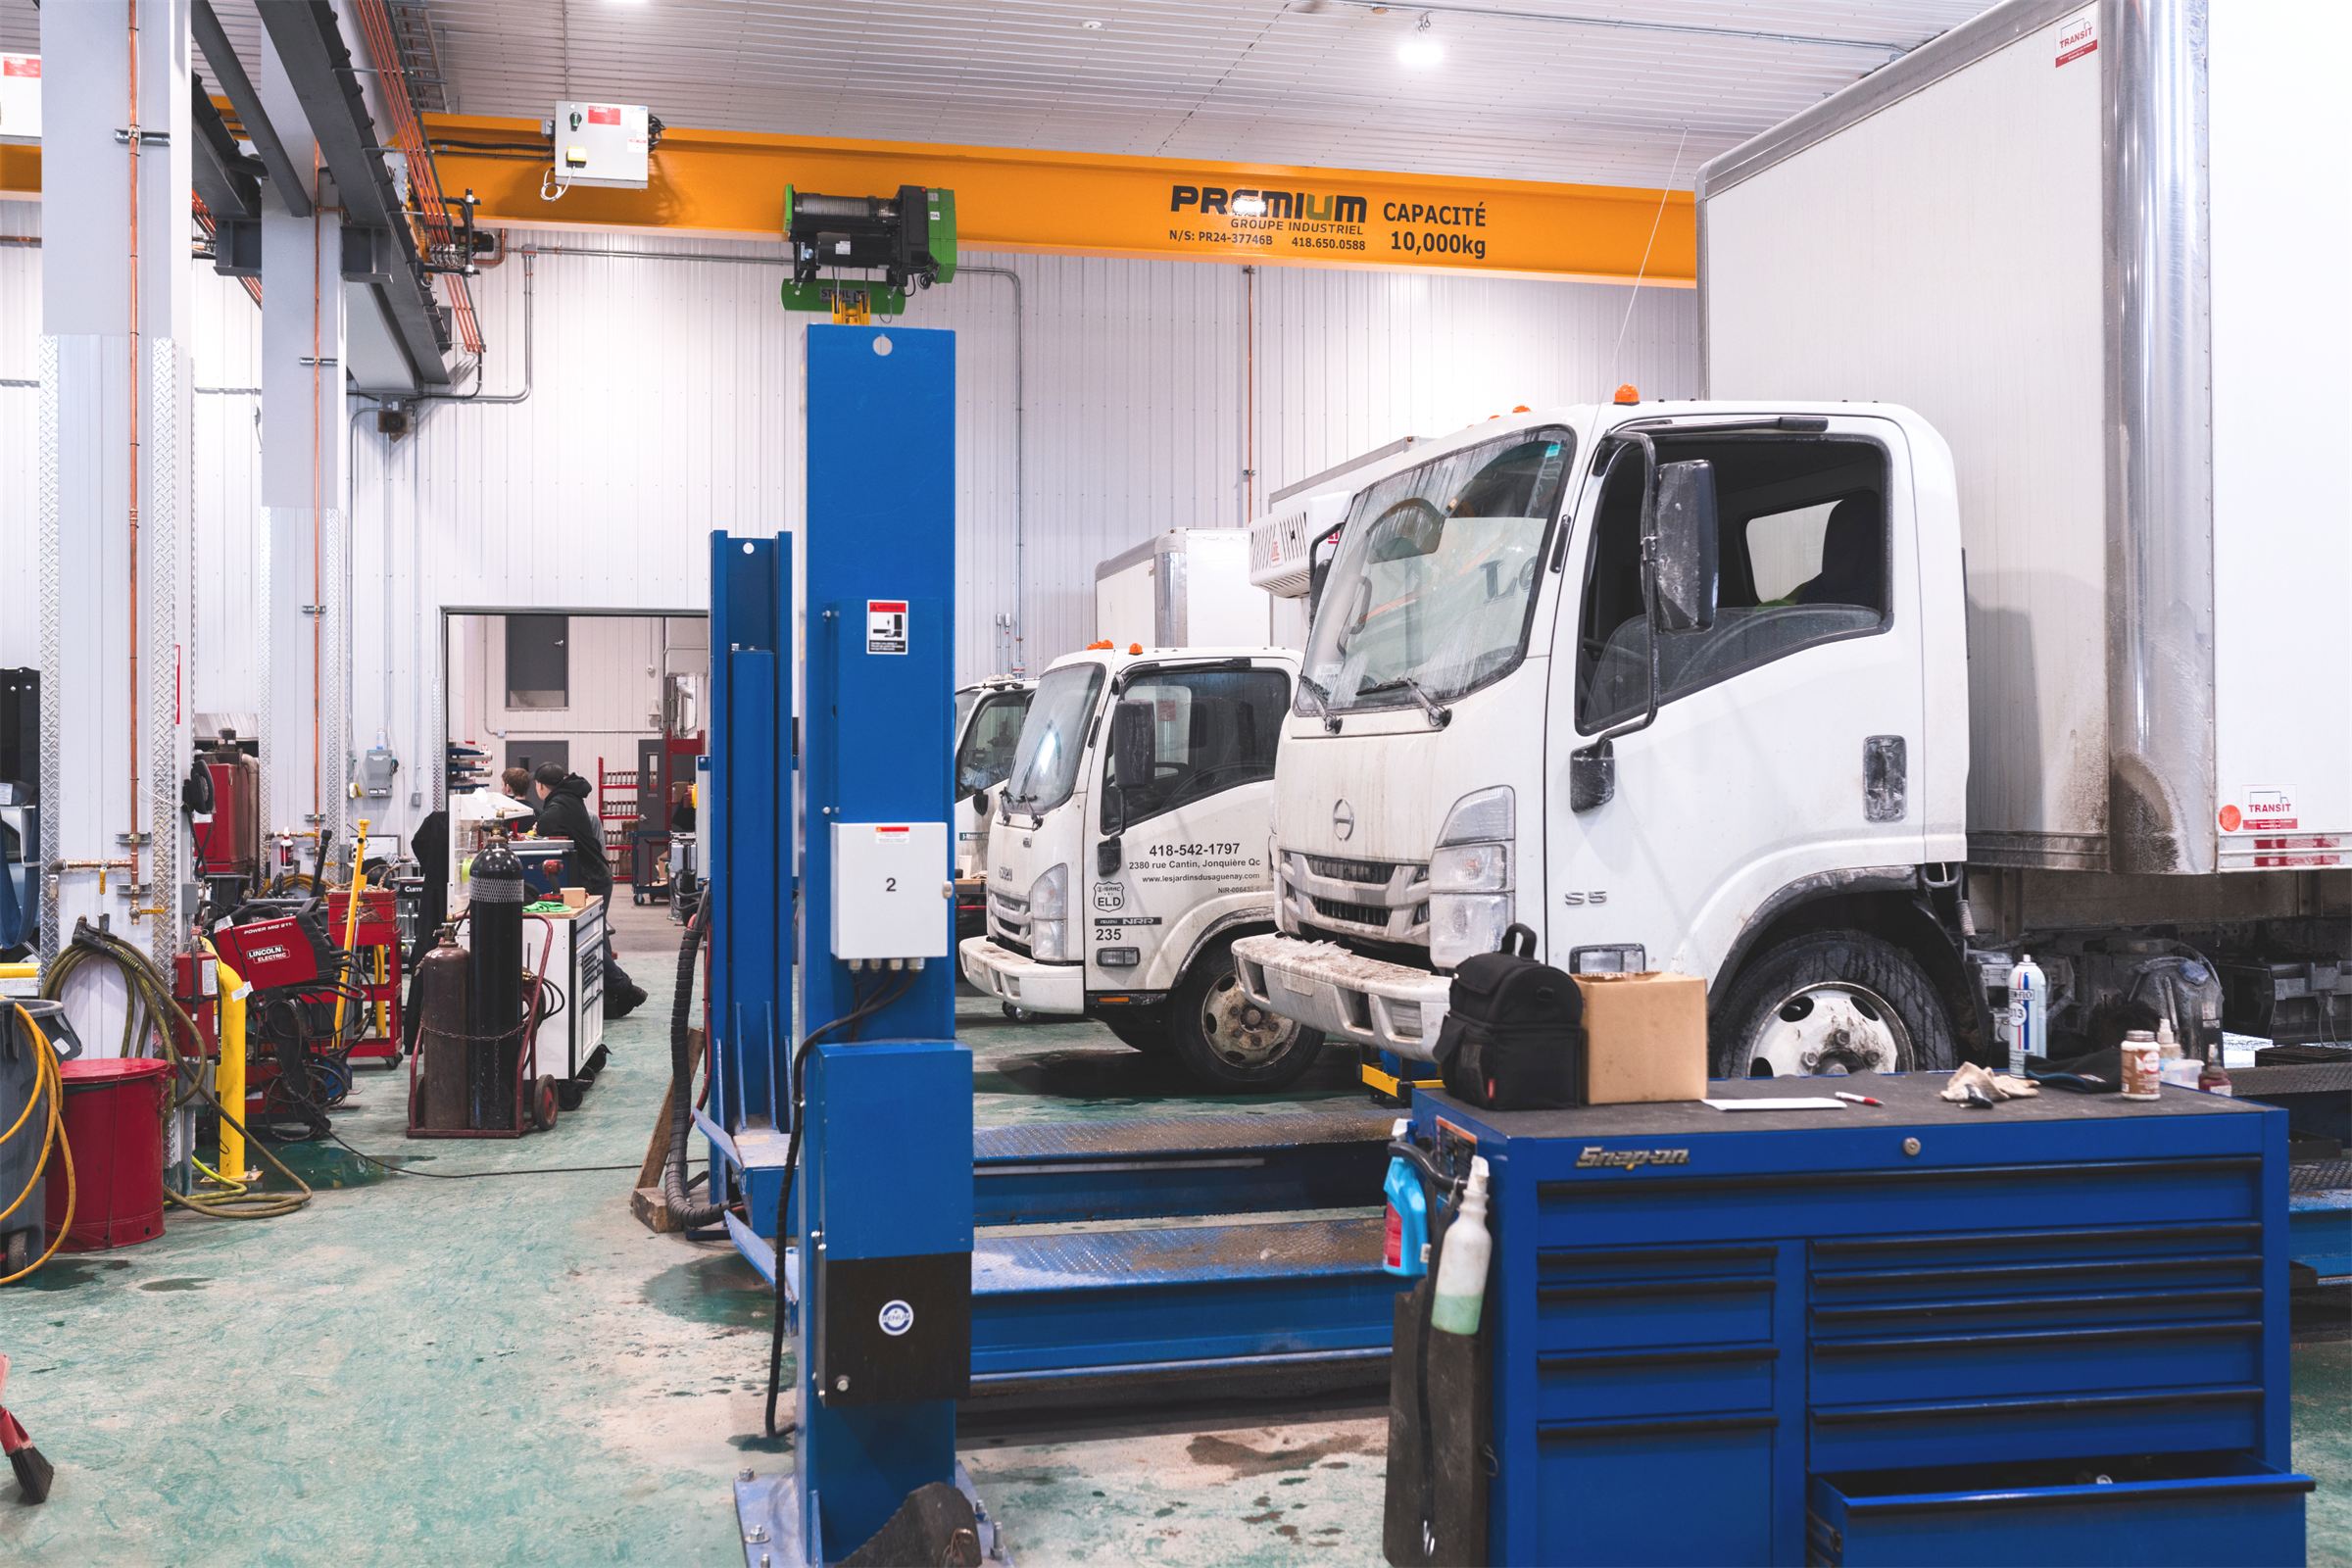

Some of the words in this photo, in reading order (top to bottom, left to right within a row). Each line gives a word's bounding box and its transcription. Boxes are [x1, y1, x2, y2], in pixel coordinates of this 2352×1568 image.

[2059, 26, 2093, 49] TRANSIT
[1383, 201, 1486, 226] CAPACITÉ
[1231, 218, 1284, 231] GROUPE
[1288, 220, 1364, 235] INDUSTRIEL
[1169, 229, 1195, 241] N/S:
[1199, 230, 1273, 245] PR24-37746B
[1292, 236, 1366, 251] 418.650.0588
[1391, 230, 1486, 260] 10,000kg
[2248, 803, 2291, 812] TRANSIT
[1149, 843, 1240, 857] 418-542-1797
[1129, 860, 1150, 870] 2380
[1168, 859, 1200, 868] Cantin,
[1202, 858, 1247, 868] Jonquière
[1248, 858, 1261, 866] Qc
[885, 877, 897, 892] 2
[1142, 873, 1260, 883] www.lesjardinsdusaguenay.com
[1098, 897, 1121, 906] ELD
[1096, 928, 1122, 941] 235
[248, 946, 281, 957] LINCOLN
[257, 952, 287, 962] ELECTRIC
[1575, 1146, 1690, 1171] Snap-on
